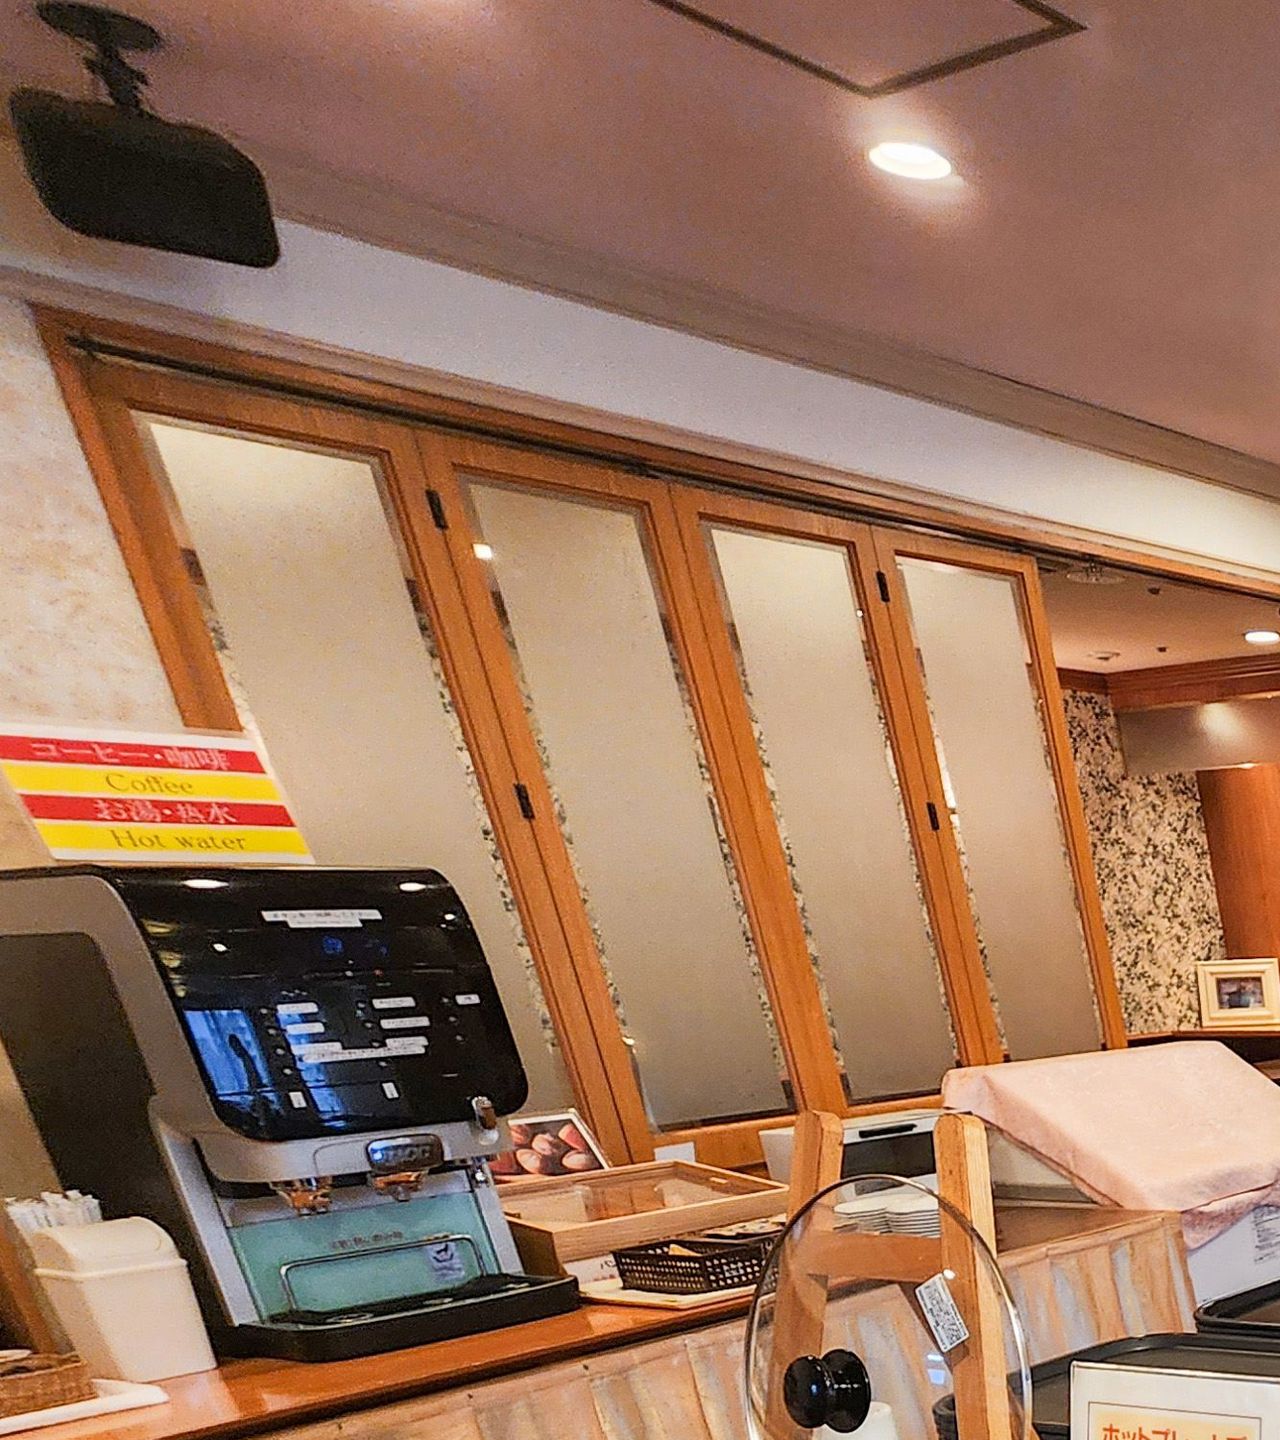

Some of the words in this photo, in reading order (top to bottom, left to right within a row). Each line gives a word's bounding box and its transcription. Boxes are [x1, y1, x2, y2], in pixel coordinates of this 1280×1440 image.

[105, 773, 194, 794] Coffee
[110, 830, 167, 848] Hot
[175, 837, 247, 850] water
